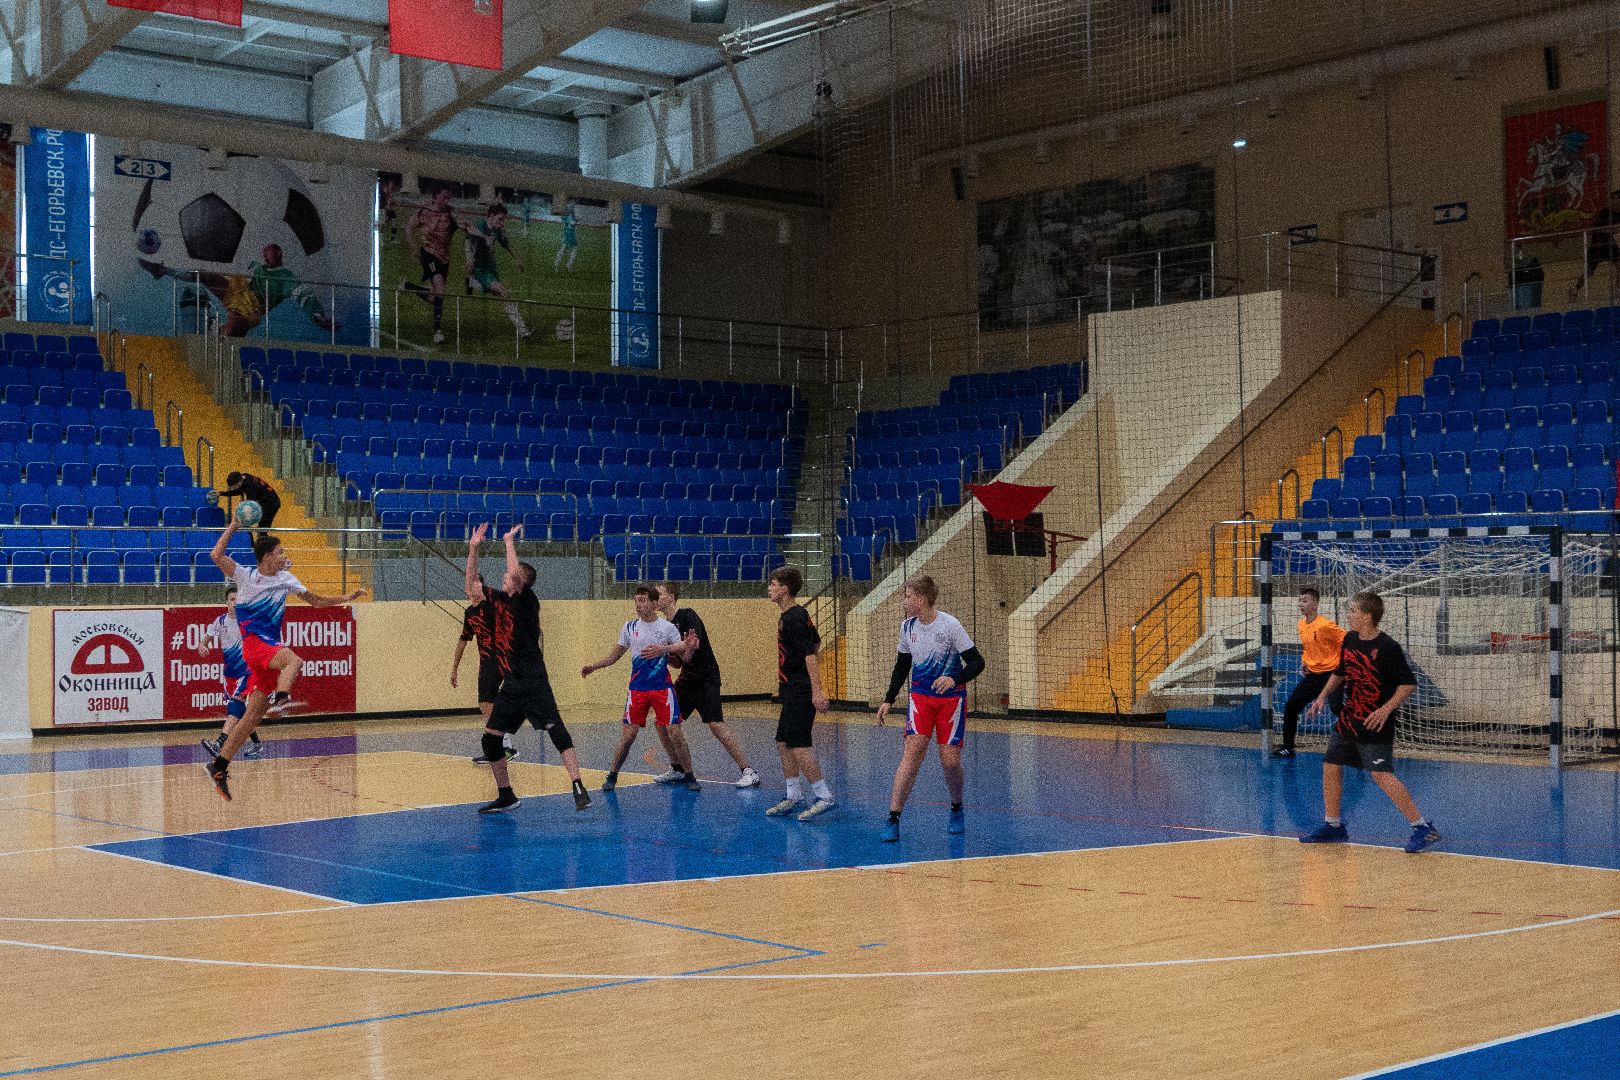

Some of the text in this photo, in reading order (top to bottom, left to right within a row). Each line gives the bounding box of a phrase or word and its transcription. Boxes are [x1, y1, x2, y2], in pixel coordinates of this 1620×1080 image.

[131, 161, 156, 175] 2 3
[281, 621, 352, 647] ЛКОНЫ
